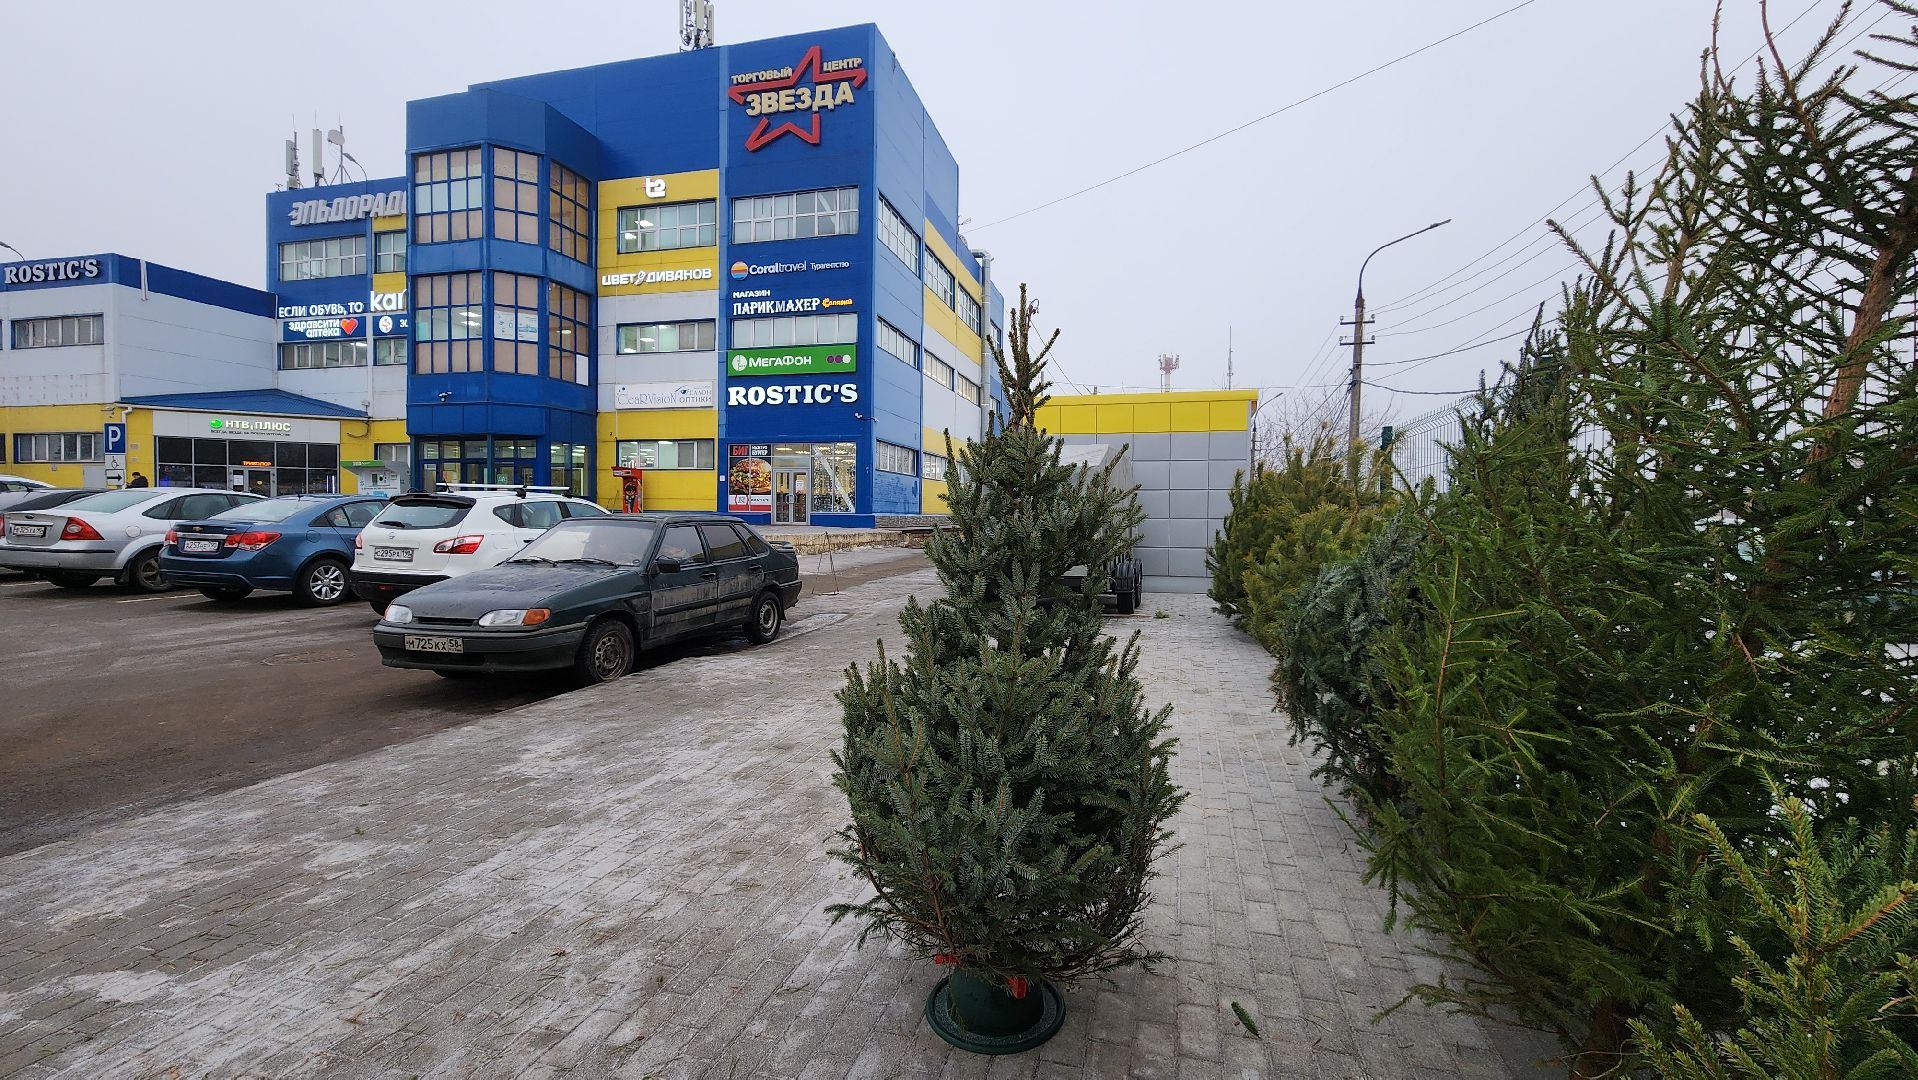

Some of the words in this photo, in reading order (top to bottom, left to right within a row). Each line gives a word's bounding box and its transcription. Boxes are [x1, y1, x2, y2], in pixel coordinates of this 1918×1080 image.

[731, 66, 793, 84] ТОРГОВЫЙ
[823, 57, 862, 72] ЦЕНТР
[746, 82, 855, 116] ЗВЕЗДА
[4, 259, 99, 284] ROSTIC'S
[602, 273, 636, 286] ЦВЕТ
[646, 268, 712, 283] ДИВАНОВ
[733, 290, 771, 299] МАГАЗИН
[279, 305, 307, 318] ЕСЛИ
[348, 302, 364, 314] ТО
[733, 298, 820, 315] ПАРИКМАХЕР
[288, 319, 340, 332] здравсити
[306, 327, 341, 338] аптека
[728, 384, 858, 406] ROSTIC'S
[108, 425, 121, 450] P
[733, 445, 749, 456] БИГ
